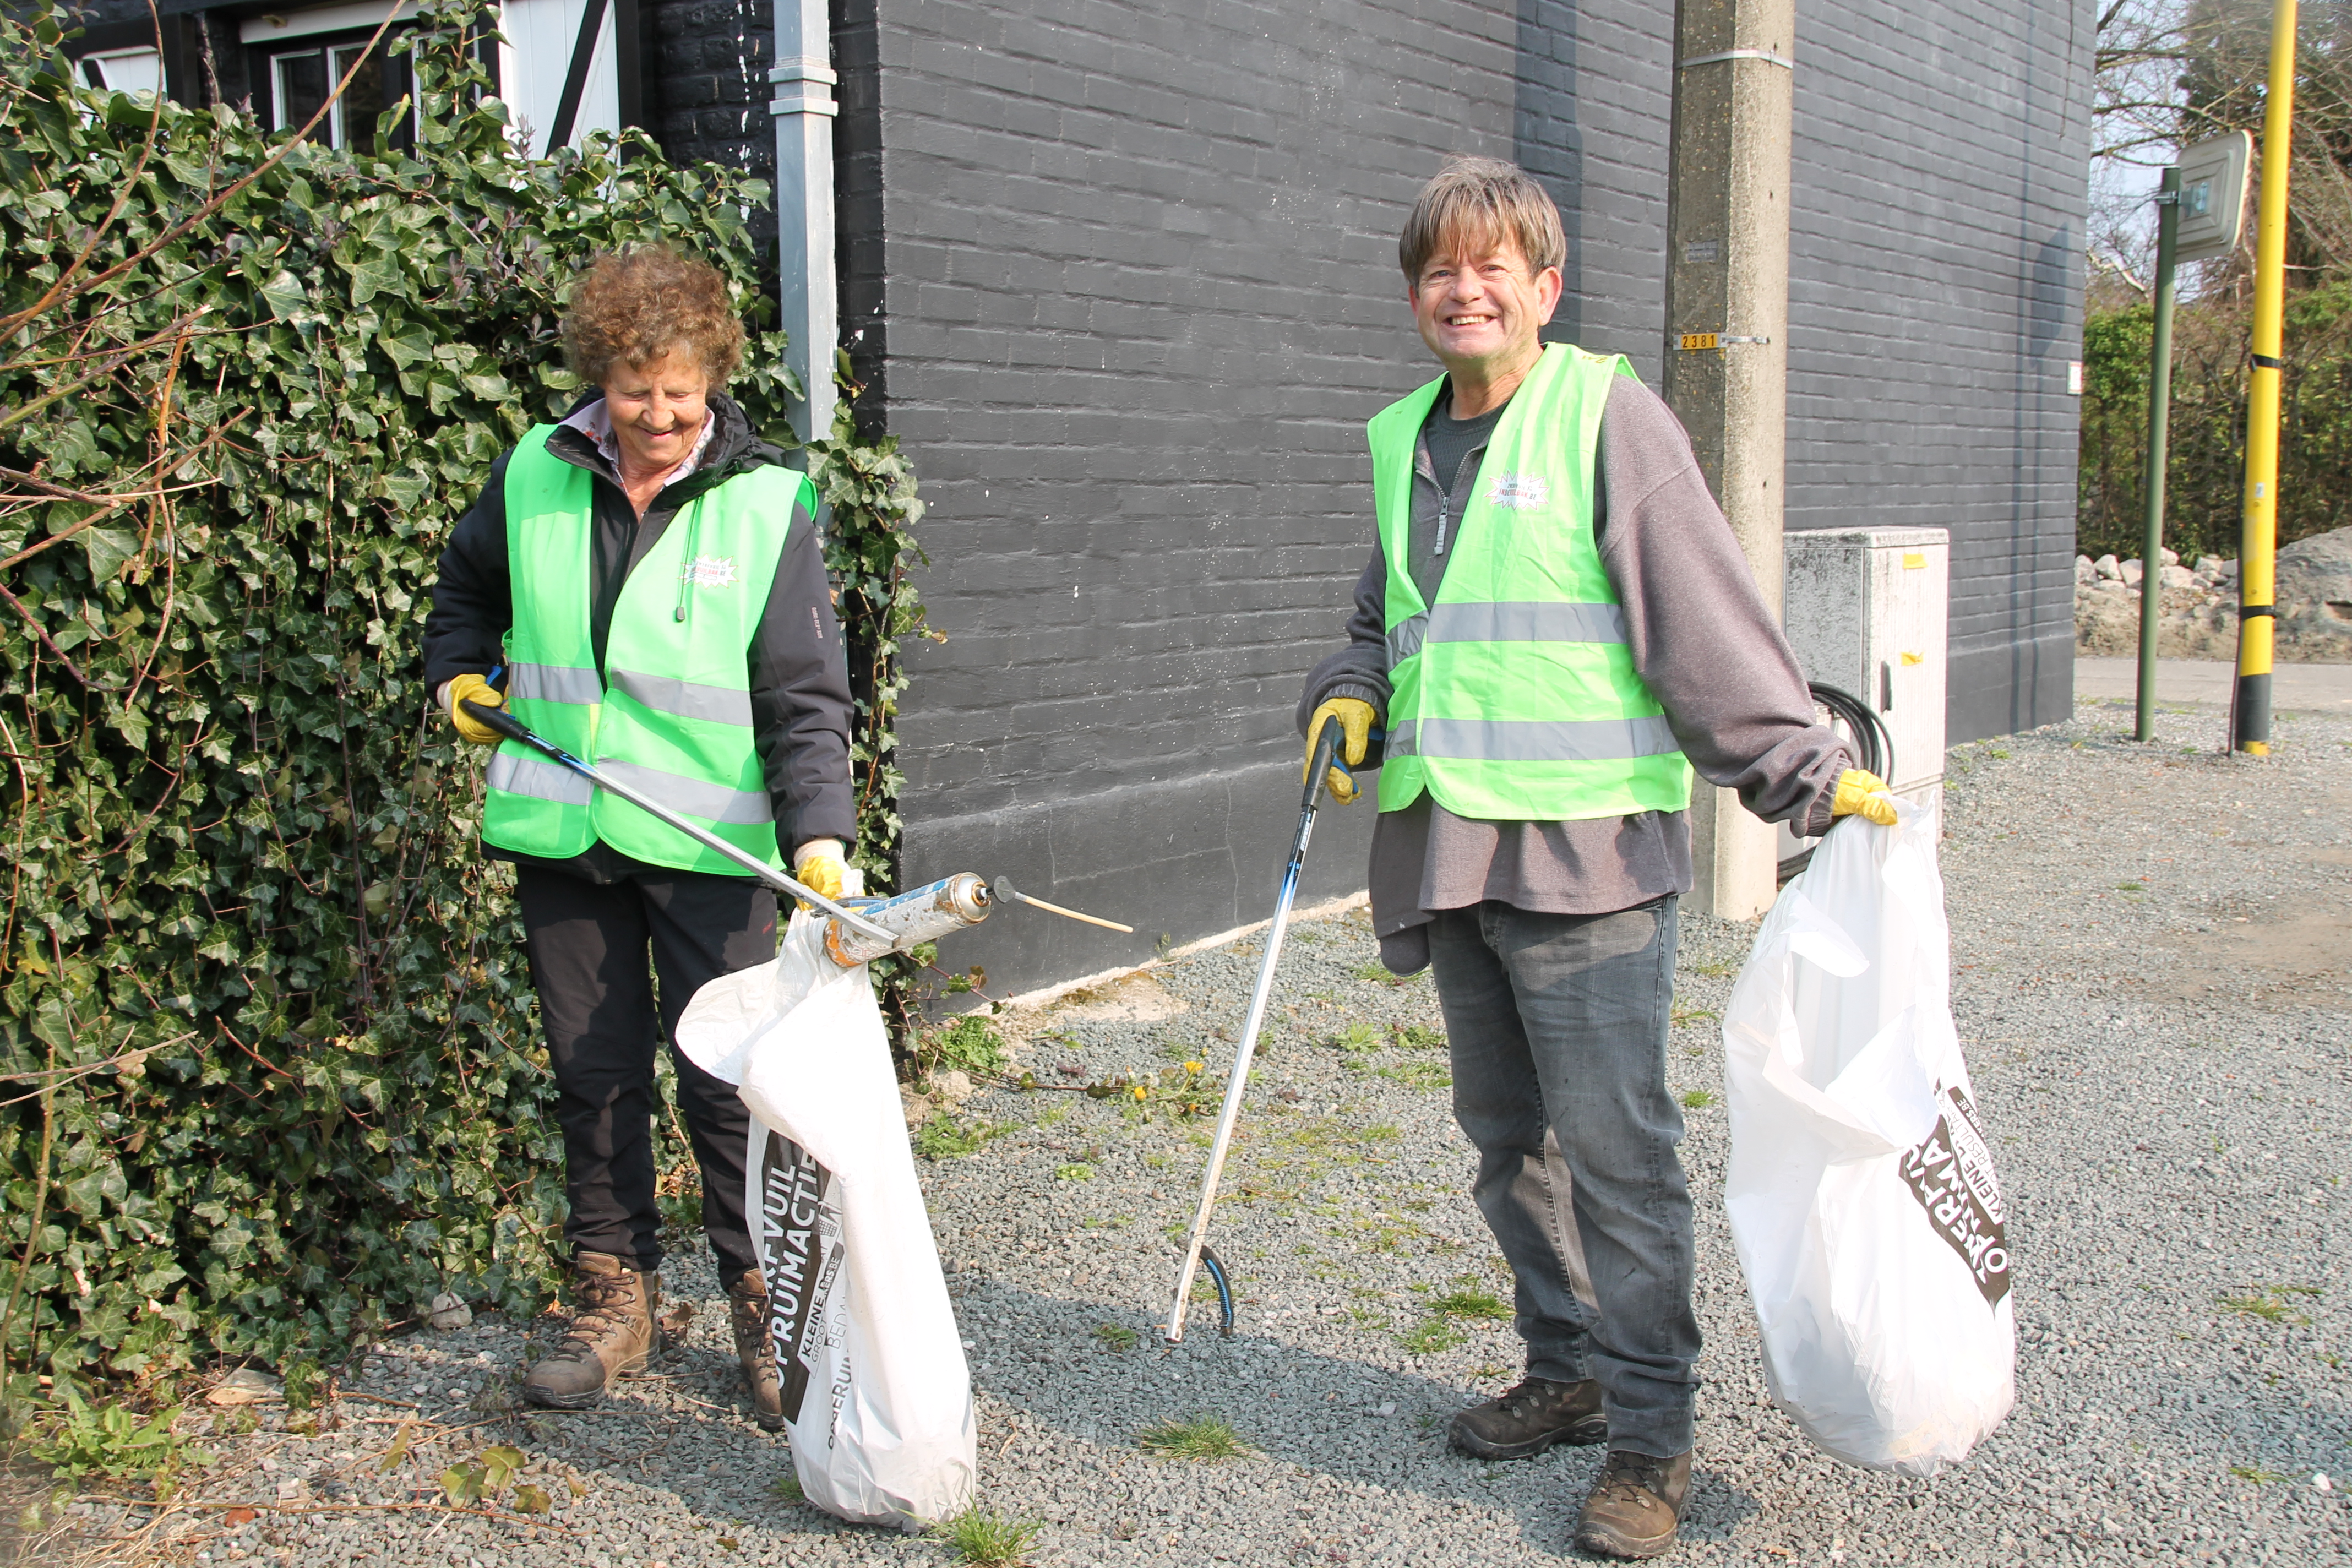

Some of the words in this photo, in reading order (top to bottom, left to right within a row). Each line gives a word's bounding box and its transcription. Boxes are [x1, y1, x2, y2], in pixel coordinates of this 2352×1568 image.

[1683, 335, 1714, 348] 2381
[1963, 1159, 2001, 1217] KLEINE
[802, 1295, 825, 1357] KLEINE
[812, 1316, 827, 1363] GROOT
